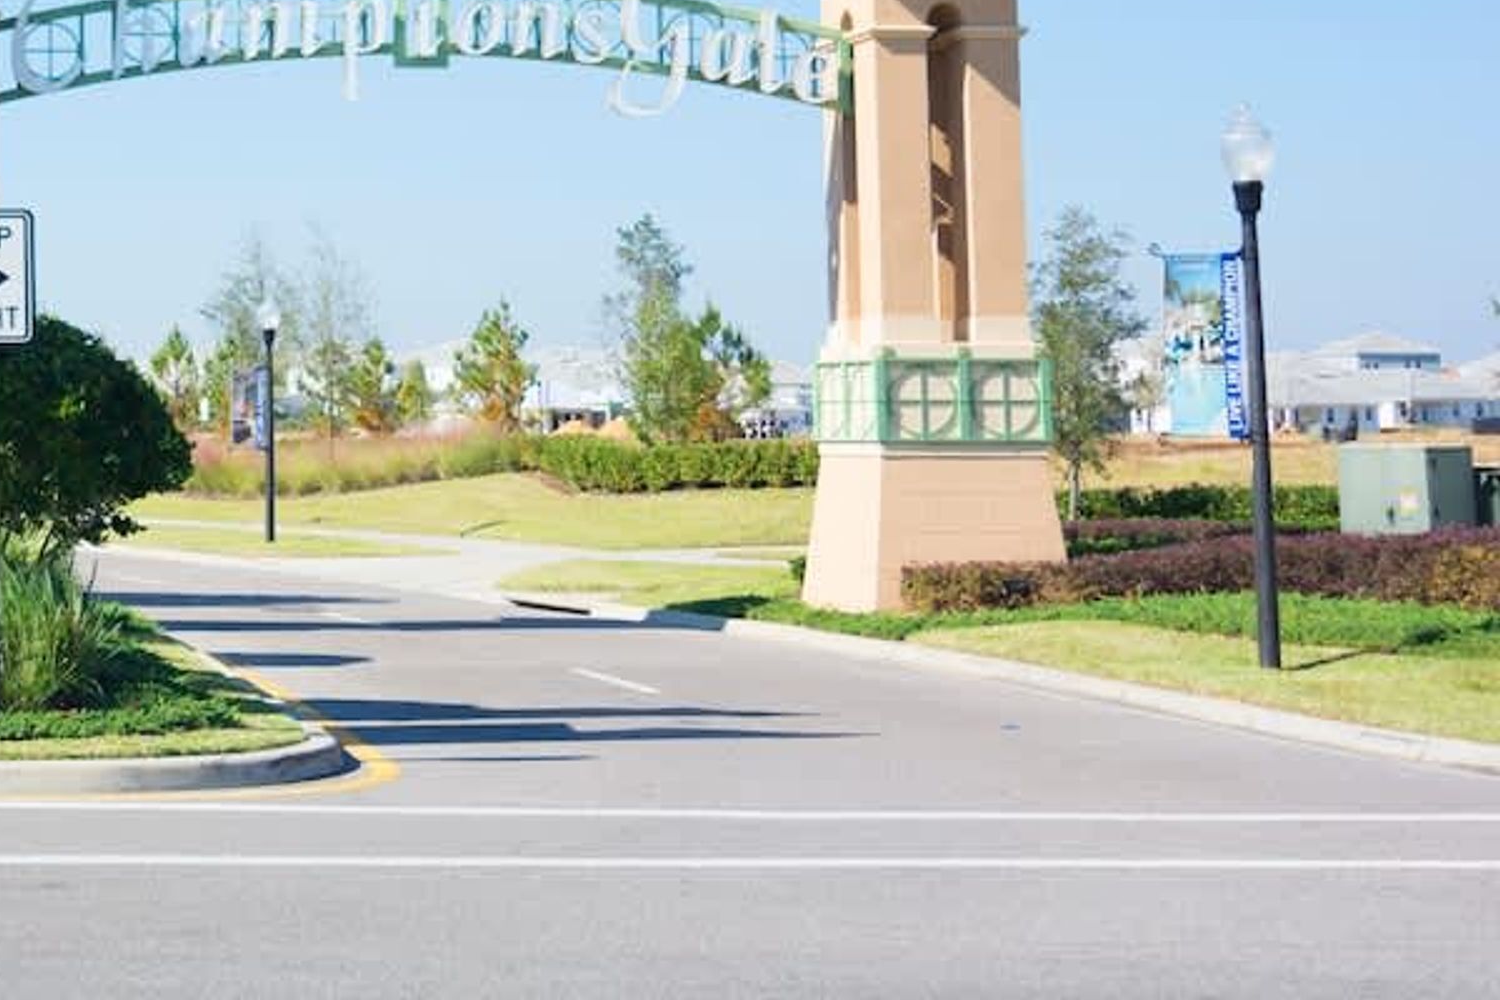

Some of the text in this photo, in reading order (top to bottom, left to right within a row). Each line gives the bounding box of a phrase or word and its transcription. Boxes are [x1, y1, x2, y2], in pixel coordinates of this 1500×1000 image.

[1223, 260, 1240, 341] CHAMPION
[1226, 361, 1242, 394] LIKE
[1228, 396, 1243, 430] LIVE
